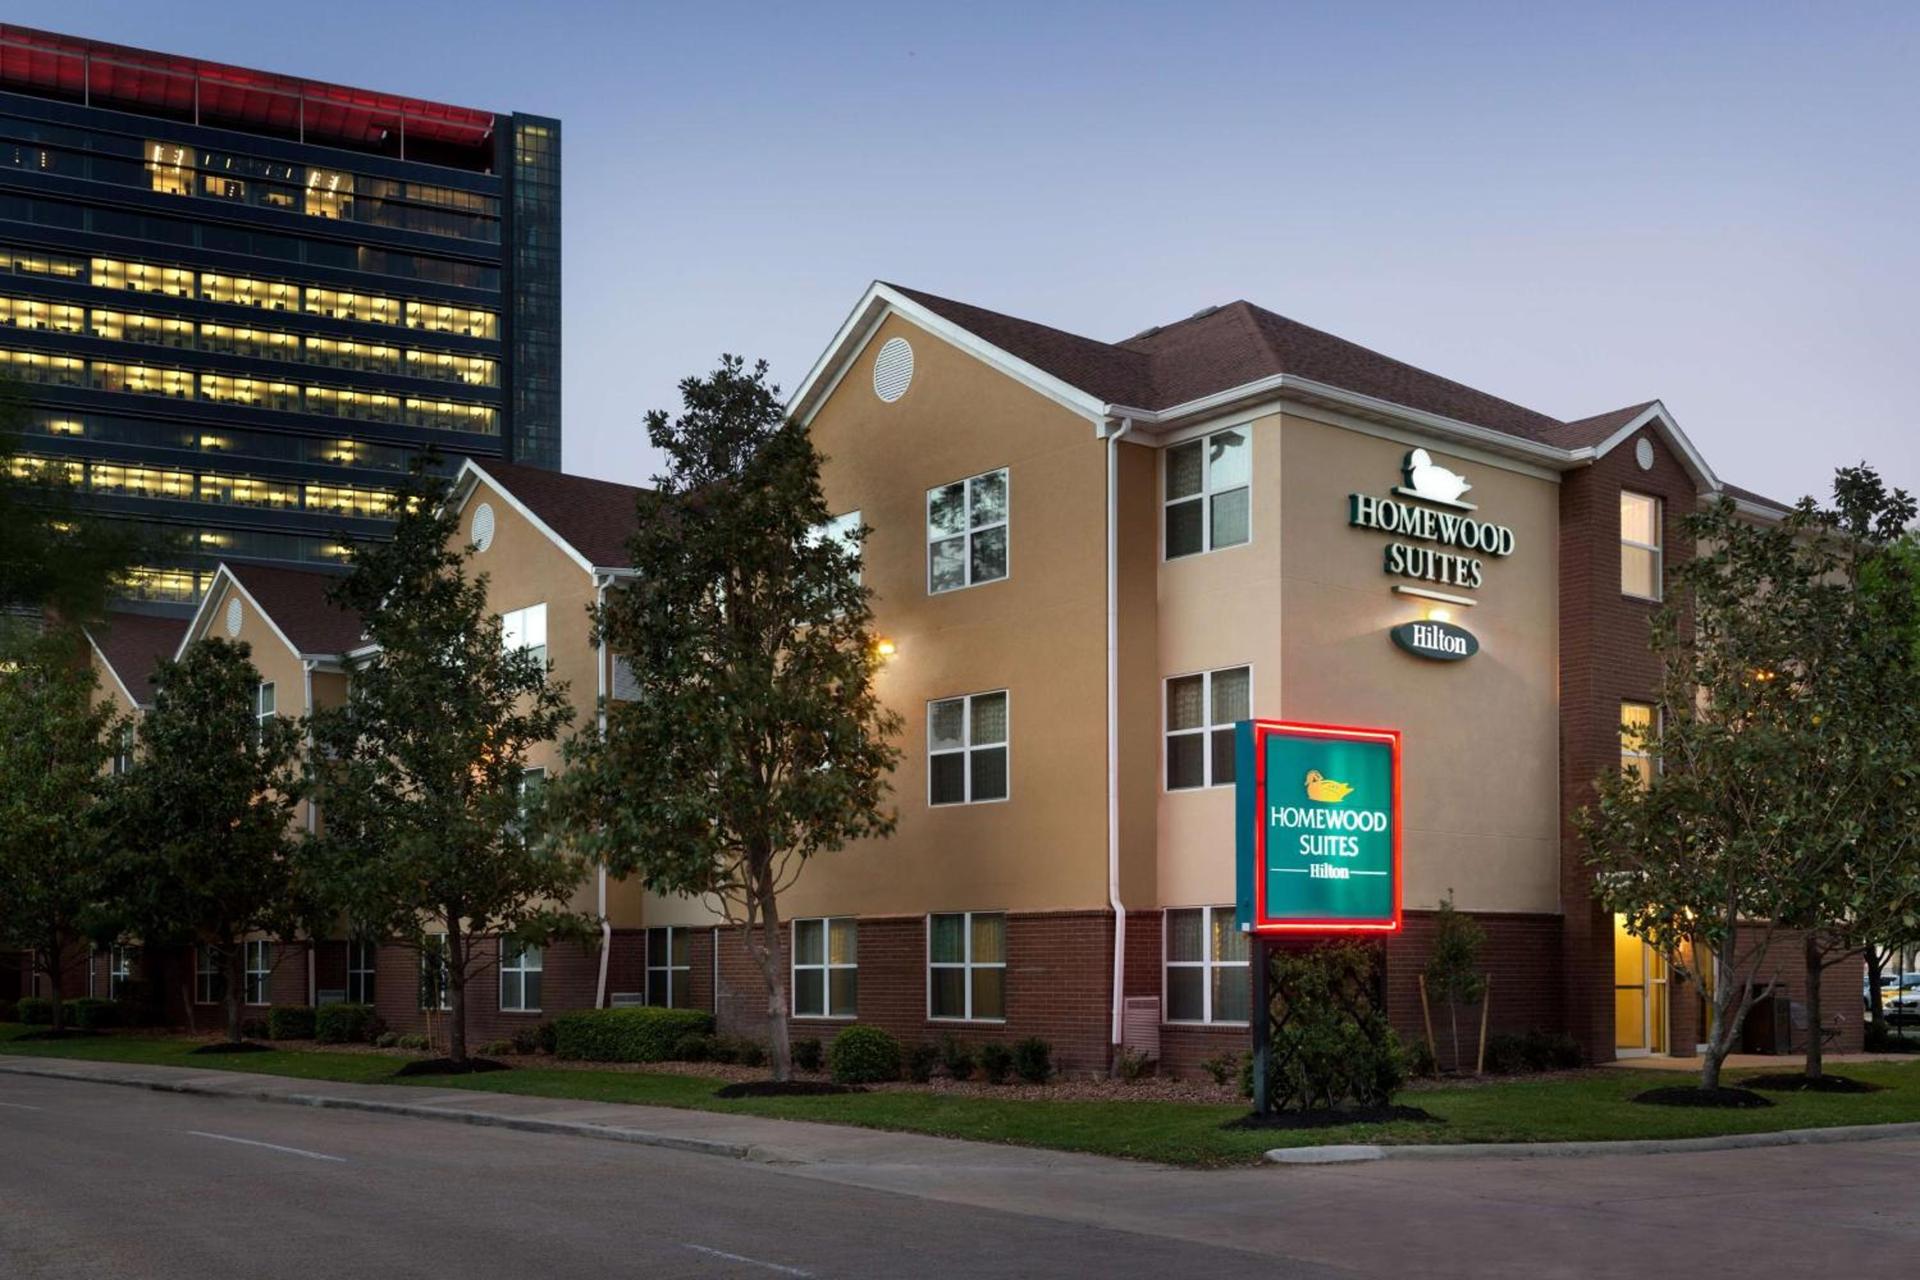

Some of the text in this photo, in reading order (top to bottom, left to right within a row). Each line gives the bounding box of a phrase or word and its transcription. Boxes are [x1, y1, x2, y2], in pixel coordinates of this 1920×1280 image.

[1353, 493, 1515, 556] HOMEWOOD
[1389, 542, 1483, 588] SUITES
[1412, 623, 1468, 655] Hilton
[1270, 806, 1388, 832] HOMEWOOD
[1299, 834, 1360, 858] SUITES
[1309, 862, 1351, 880] Hilton
